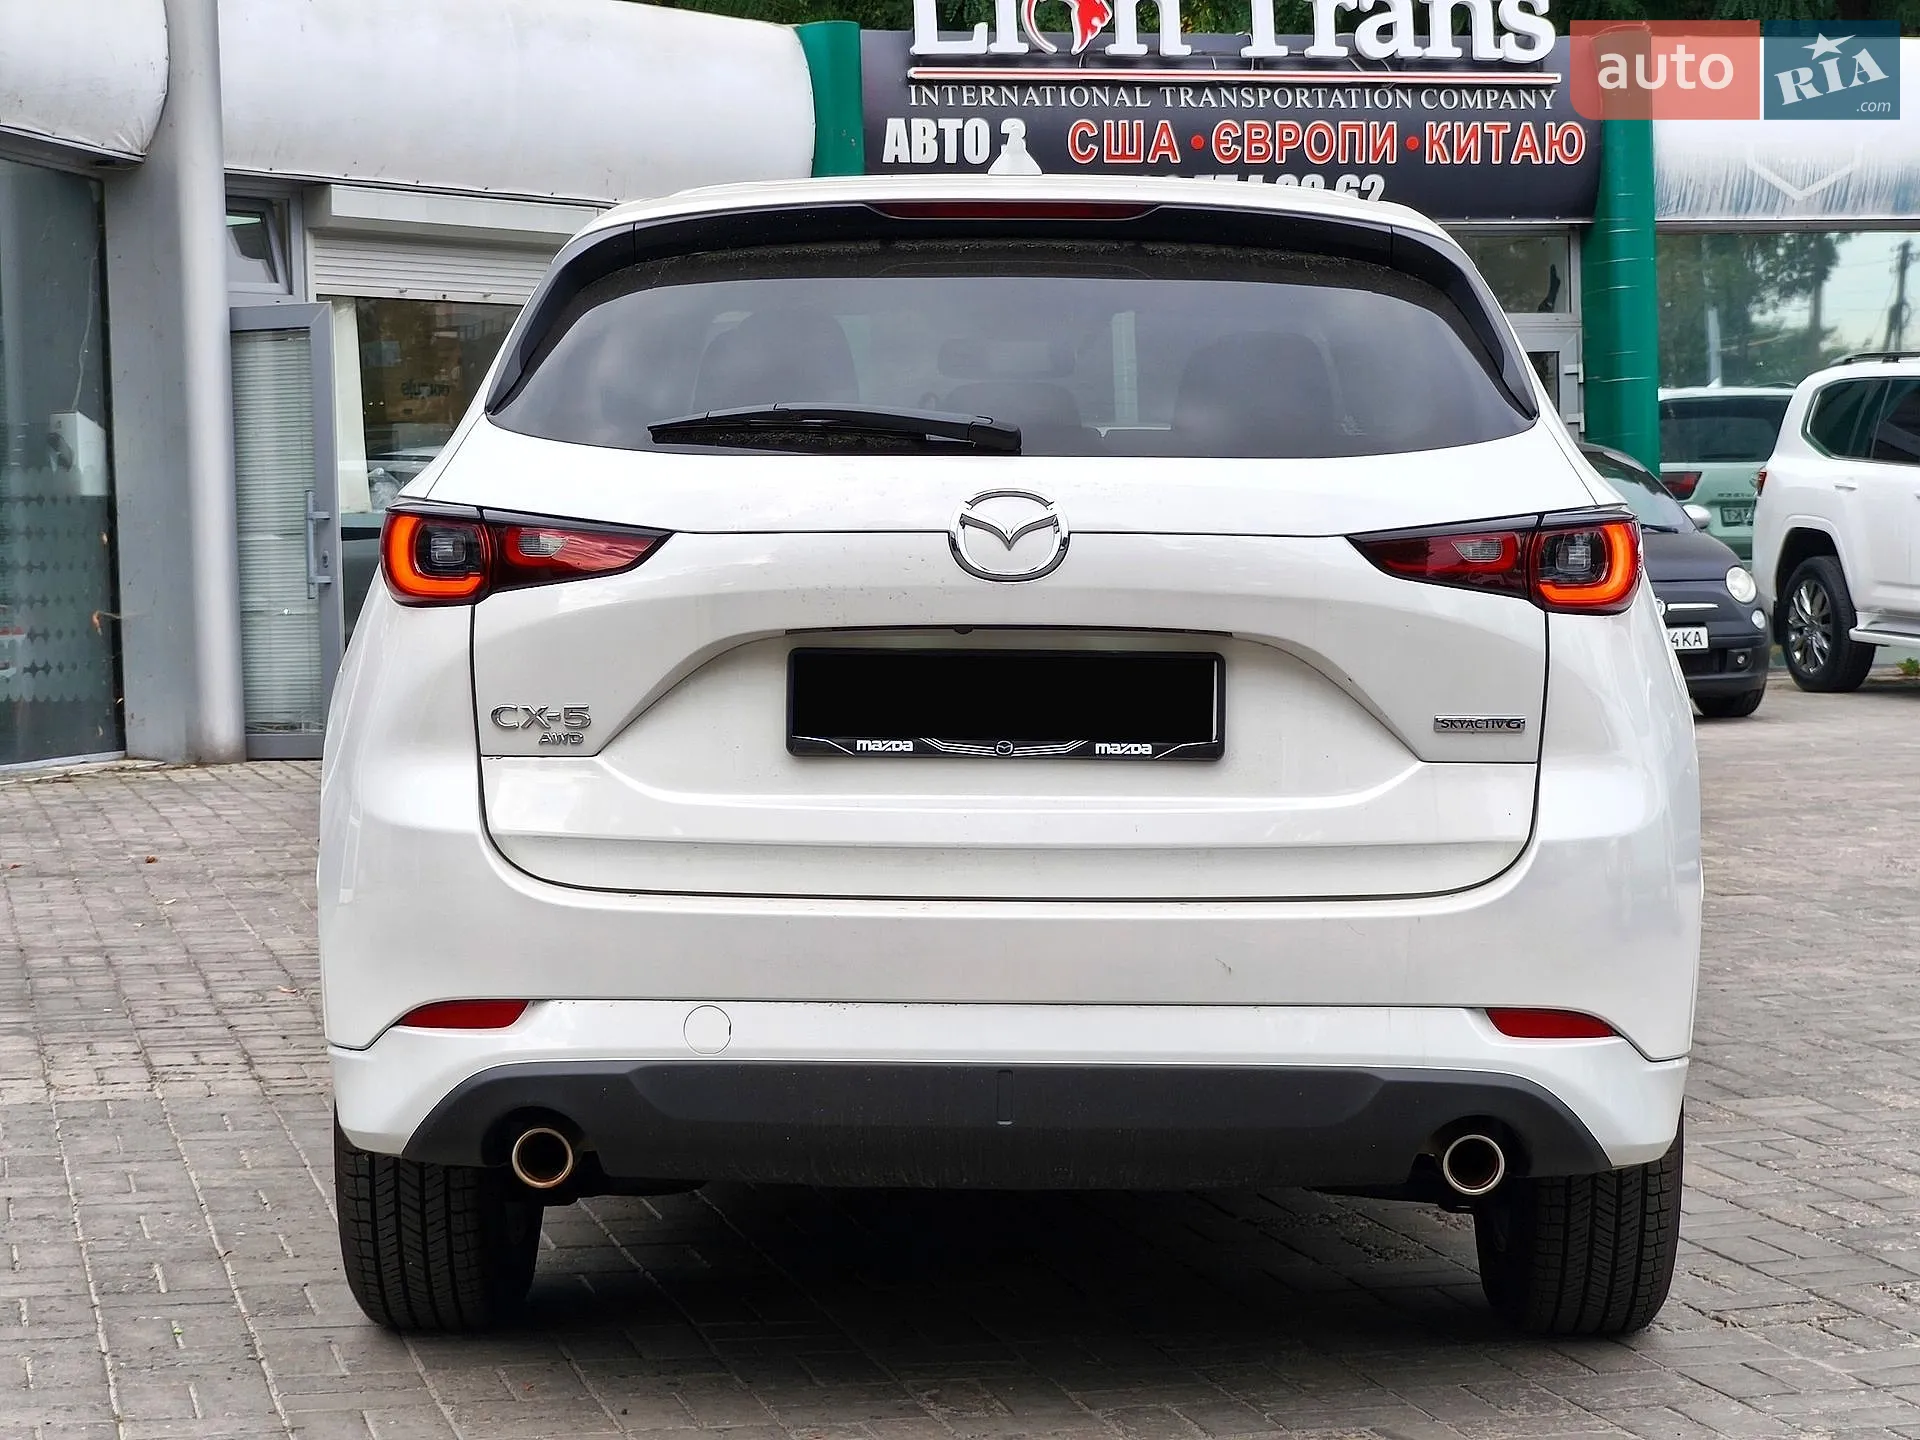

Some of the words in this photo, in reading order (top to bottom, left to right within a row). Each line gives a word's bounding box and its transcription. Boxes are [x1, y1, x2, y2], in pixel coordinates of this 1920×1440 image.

[1241, 0, 1557, 63] Trans
[909, 84, 1151, 107] INTERNATIONAL
[1159, 86, 1412, 110] TRANSPORTATION
[1420, 88, 1557, 111] COMPANY
[882, 118, 990, 164] АВТО
[1067, 119, 1182, 164] США
[1211, 120, 1398, 165] ЄВРОПИ
[1425, 121, 1586, 165] КИТАЮ
[490, 703, 592, 729] CX-5
[538, 731, 585, 746] AWD
